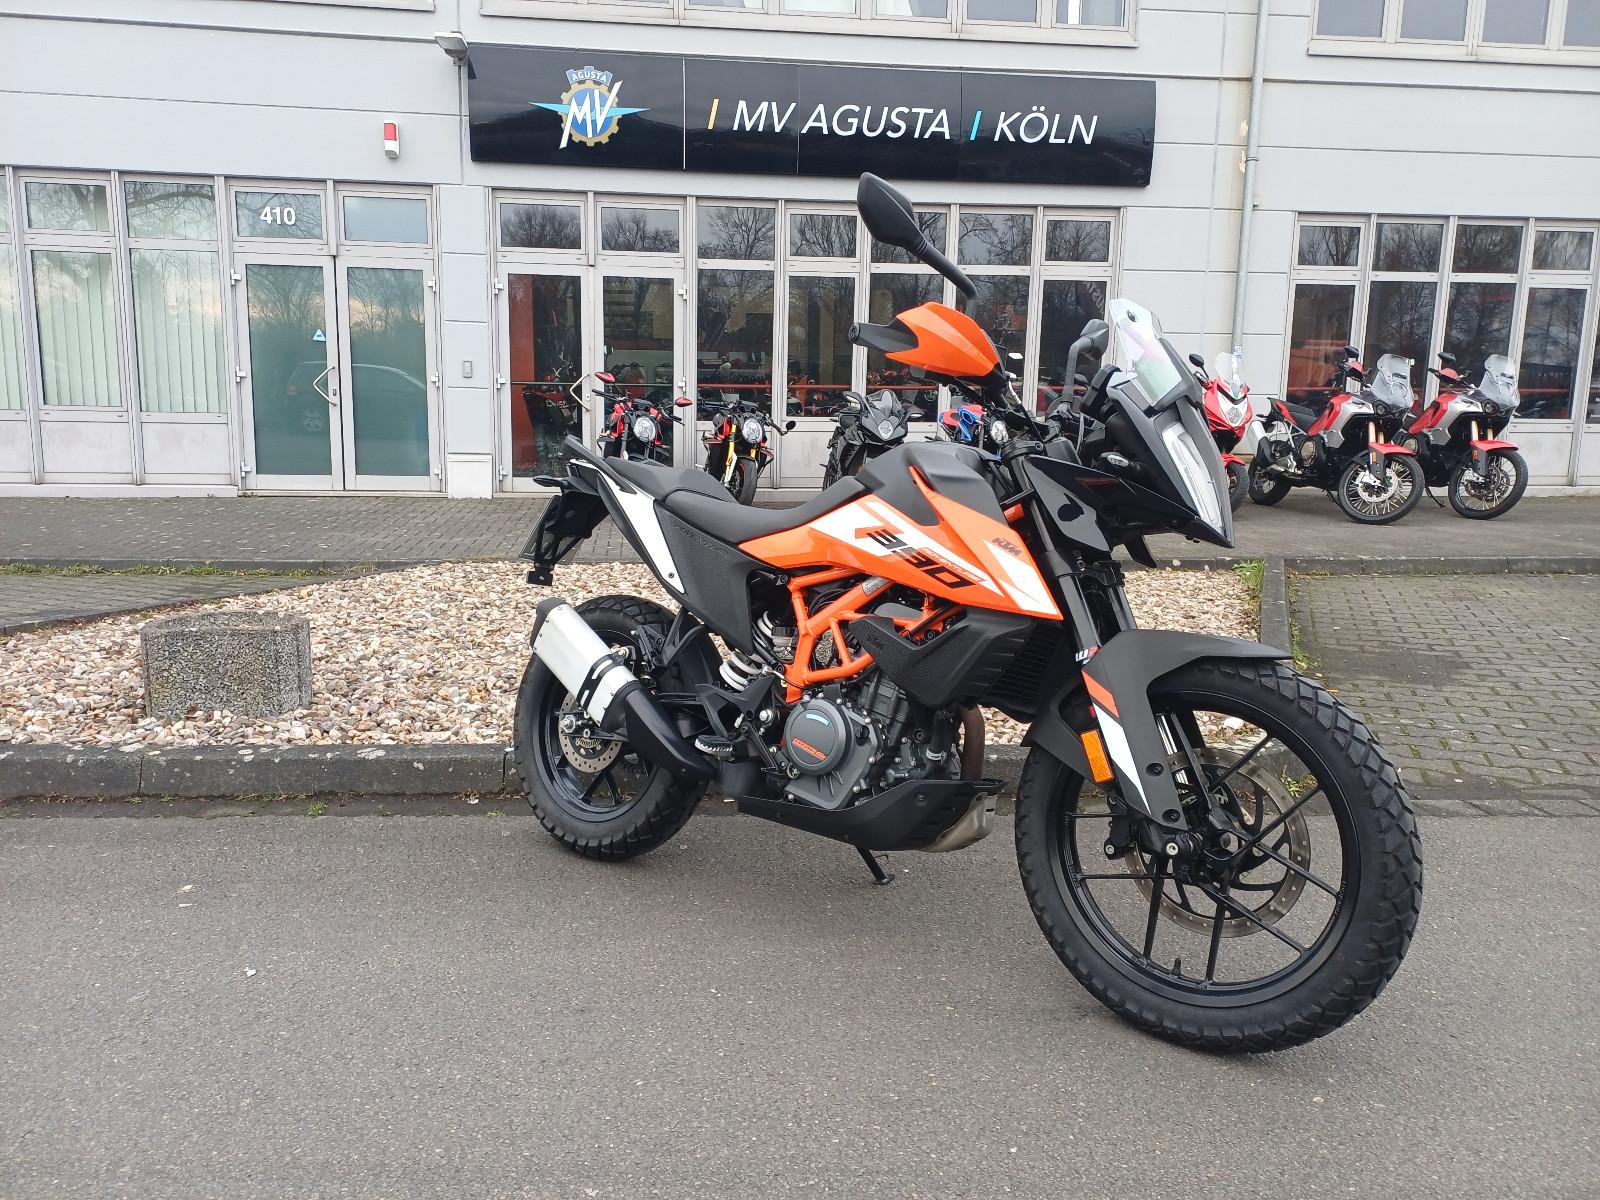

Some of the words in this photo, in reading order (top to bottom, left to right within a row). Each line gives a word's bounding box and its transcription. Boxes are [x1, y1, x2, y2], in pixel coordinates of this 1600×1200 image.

[572, 71, 607, 83] AGUSTA
[559, 80, 623, 149] MV
[733, 100, 796, 132] MV
[801, 103, 950, 139] AGUSTA
[994, 105, 1098, 144] KÖLN
[260, 206, 296, 225] 410
[991, 537, 1022, 556] KTM
